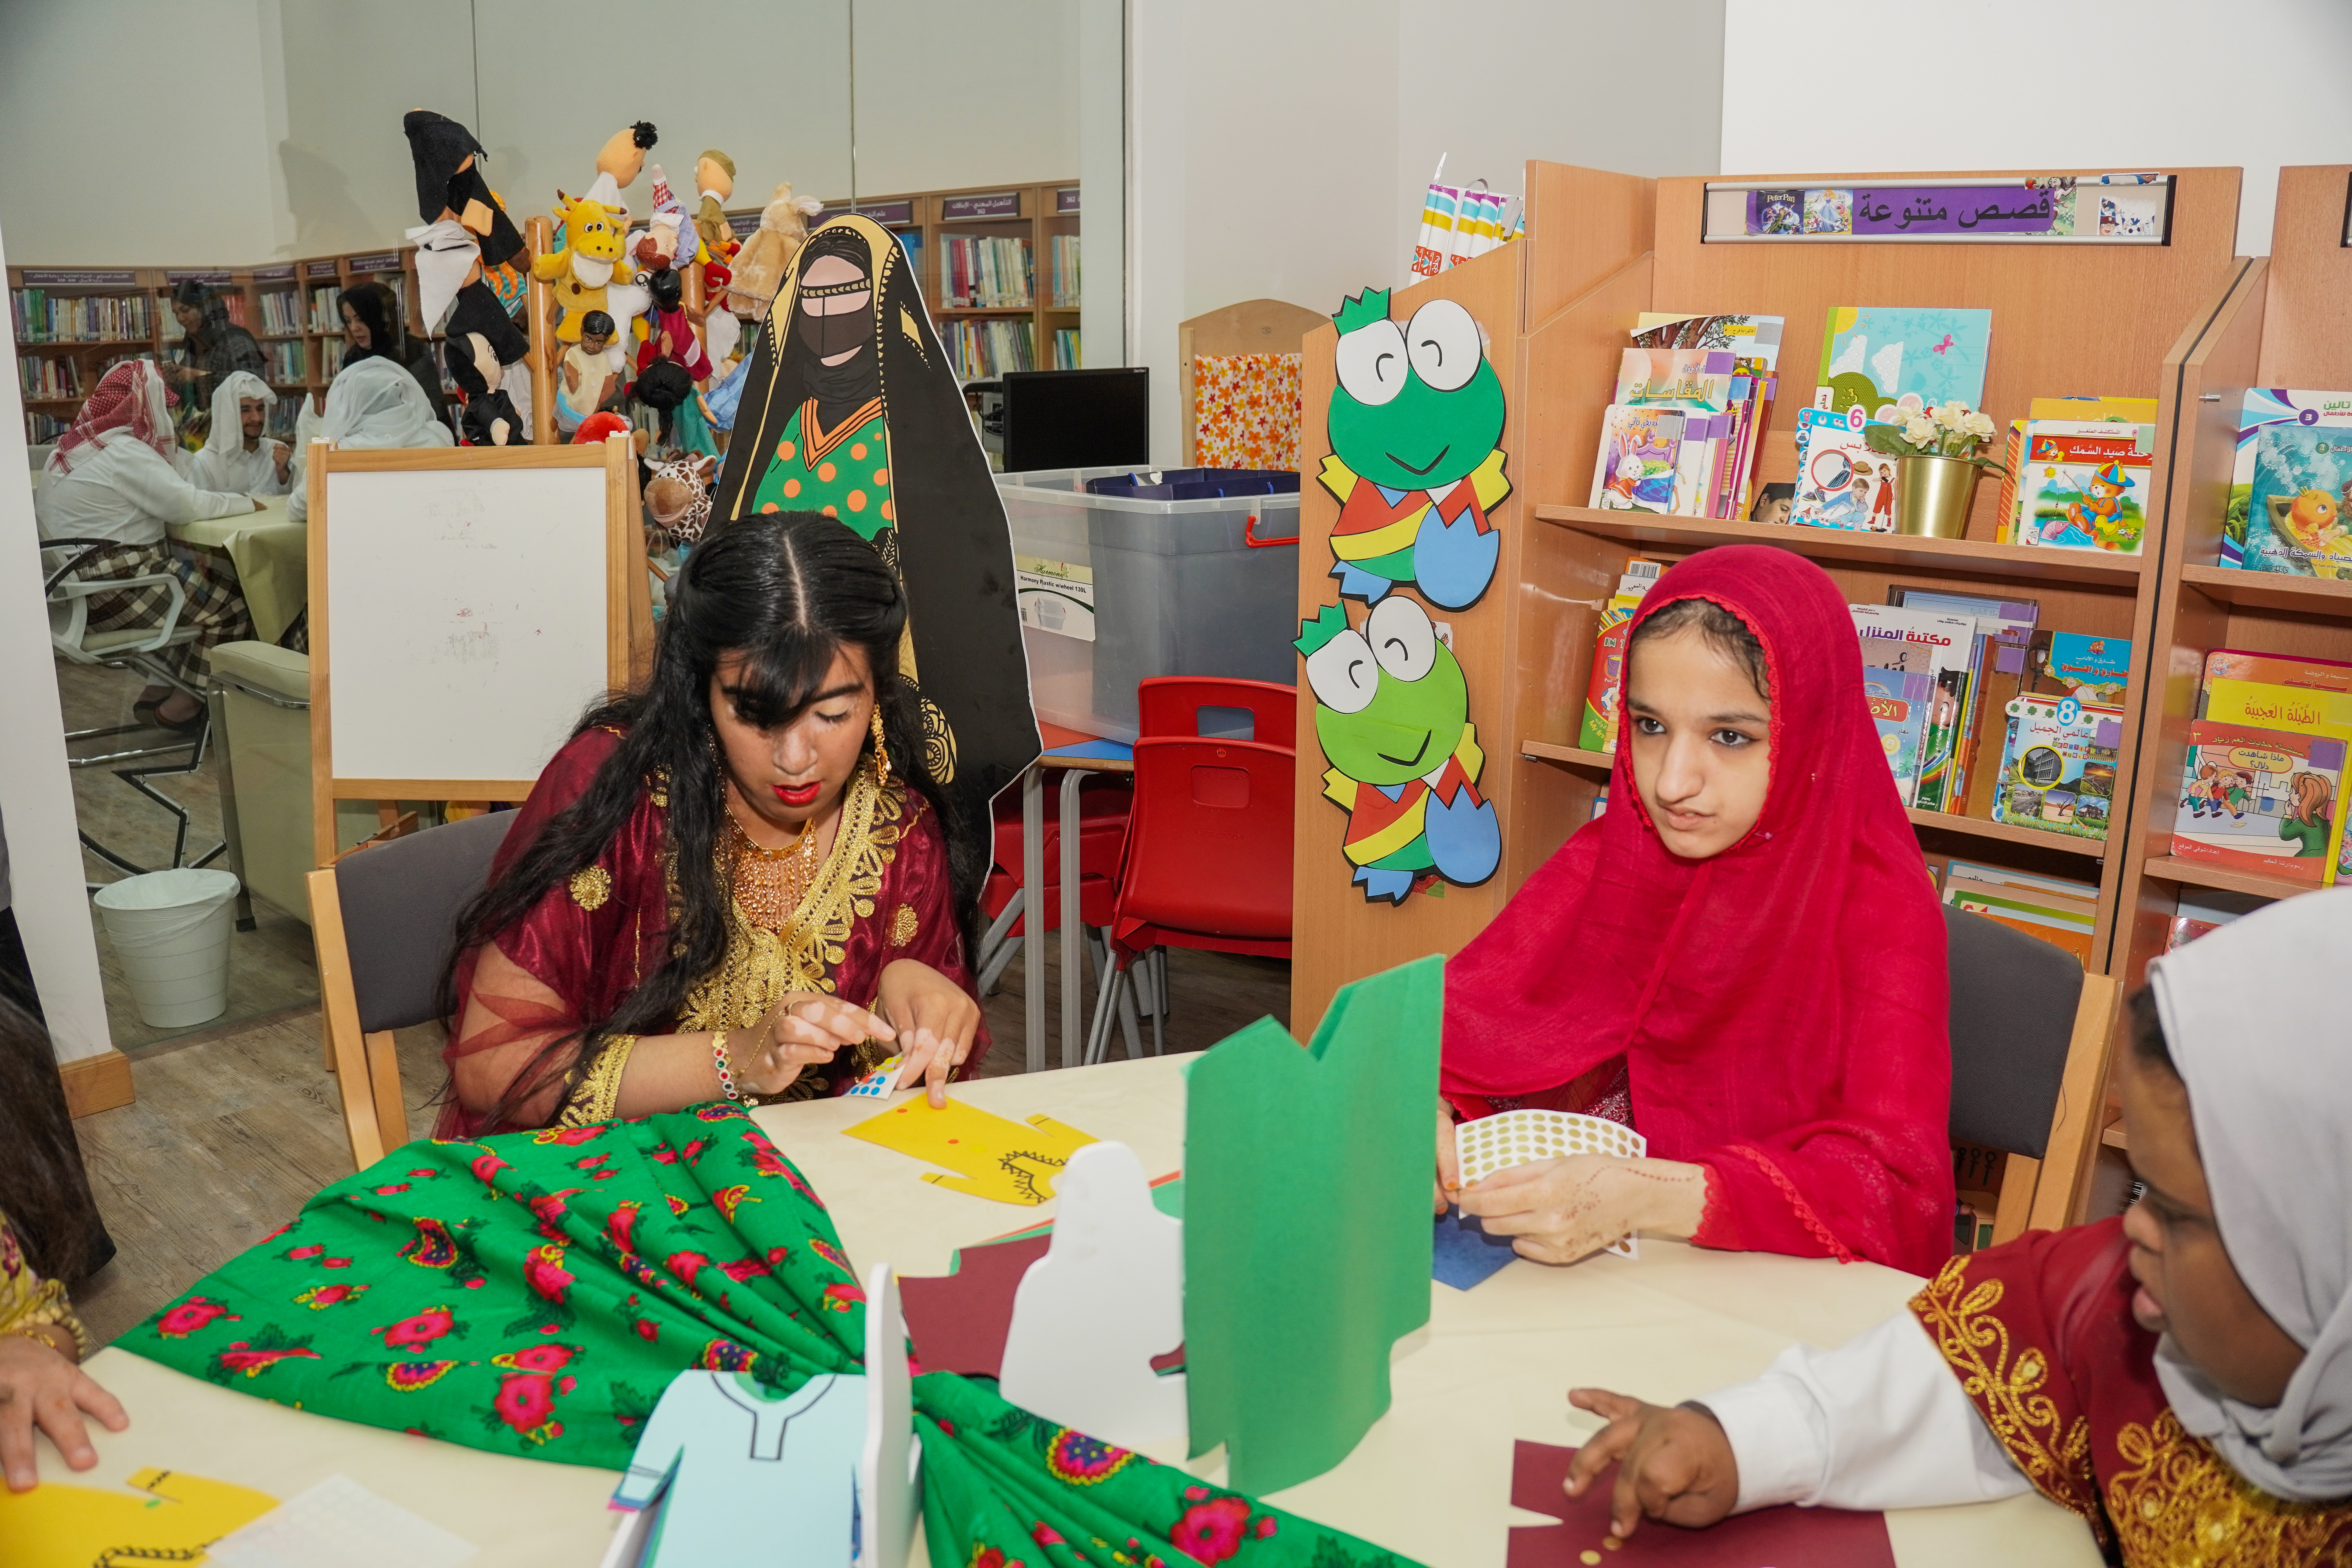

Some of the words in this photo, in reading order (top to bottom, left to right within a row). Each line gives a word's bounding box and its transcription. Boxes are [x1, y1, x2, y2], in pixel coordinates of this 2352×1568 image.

[1767, 194, 1783, 203] Peter
[1783, 194, 1795, 203] Pan
[1859, 193, 1947, 230] متنوعة
[1958, 190, 2050, 228] قصص
[1682, 362, 1700, 374] الأطفال
[1630, 379, 1714, 403] المقاسات
[2324, 401, 2351, 410] تالين
[1850, 409, 1863, 428] 6
[2259, 545, 2289, 558] الذهبية
[2290, 547, 2326, 561] والسمكة
[1034, 564, 1064, 580] Harmony
[1020, 575, 1039, 584] Harmony
[1860, 626, 1904, 640] المنزل
[1604, 637, 1617, 648] IN
[2058, 701, 2075, 723] 8
[1589, 720, 1598, 731] My
[2030, 722, 2062, 735] الجميل
[2063, 728, 2089, 740] عالمي
[2053, 741, 2101, 754] BEAUTIFUL
[2248, 739, 2274, 748] حكايات
[2274, 742, 2305, 757] سلسلة
[2062, 751, 2088, 760] WORLD
[2238, 750, 2268, 759] شاهدت
[2270, 753, 2284, 762] ماذا
[2250, 761, 2269, 769] دلال؟
